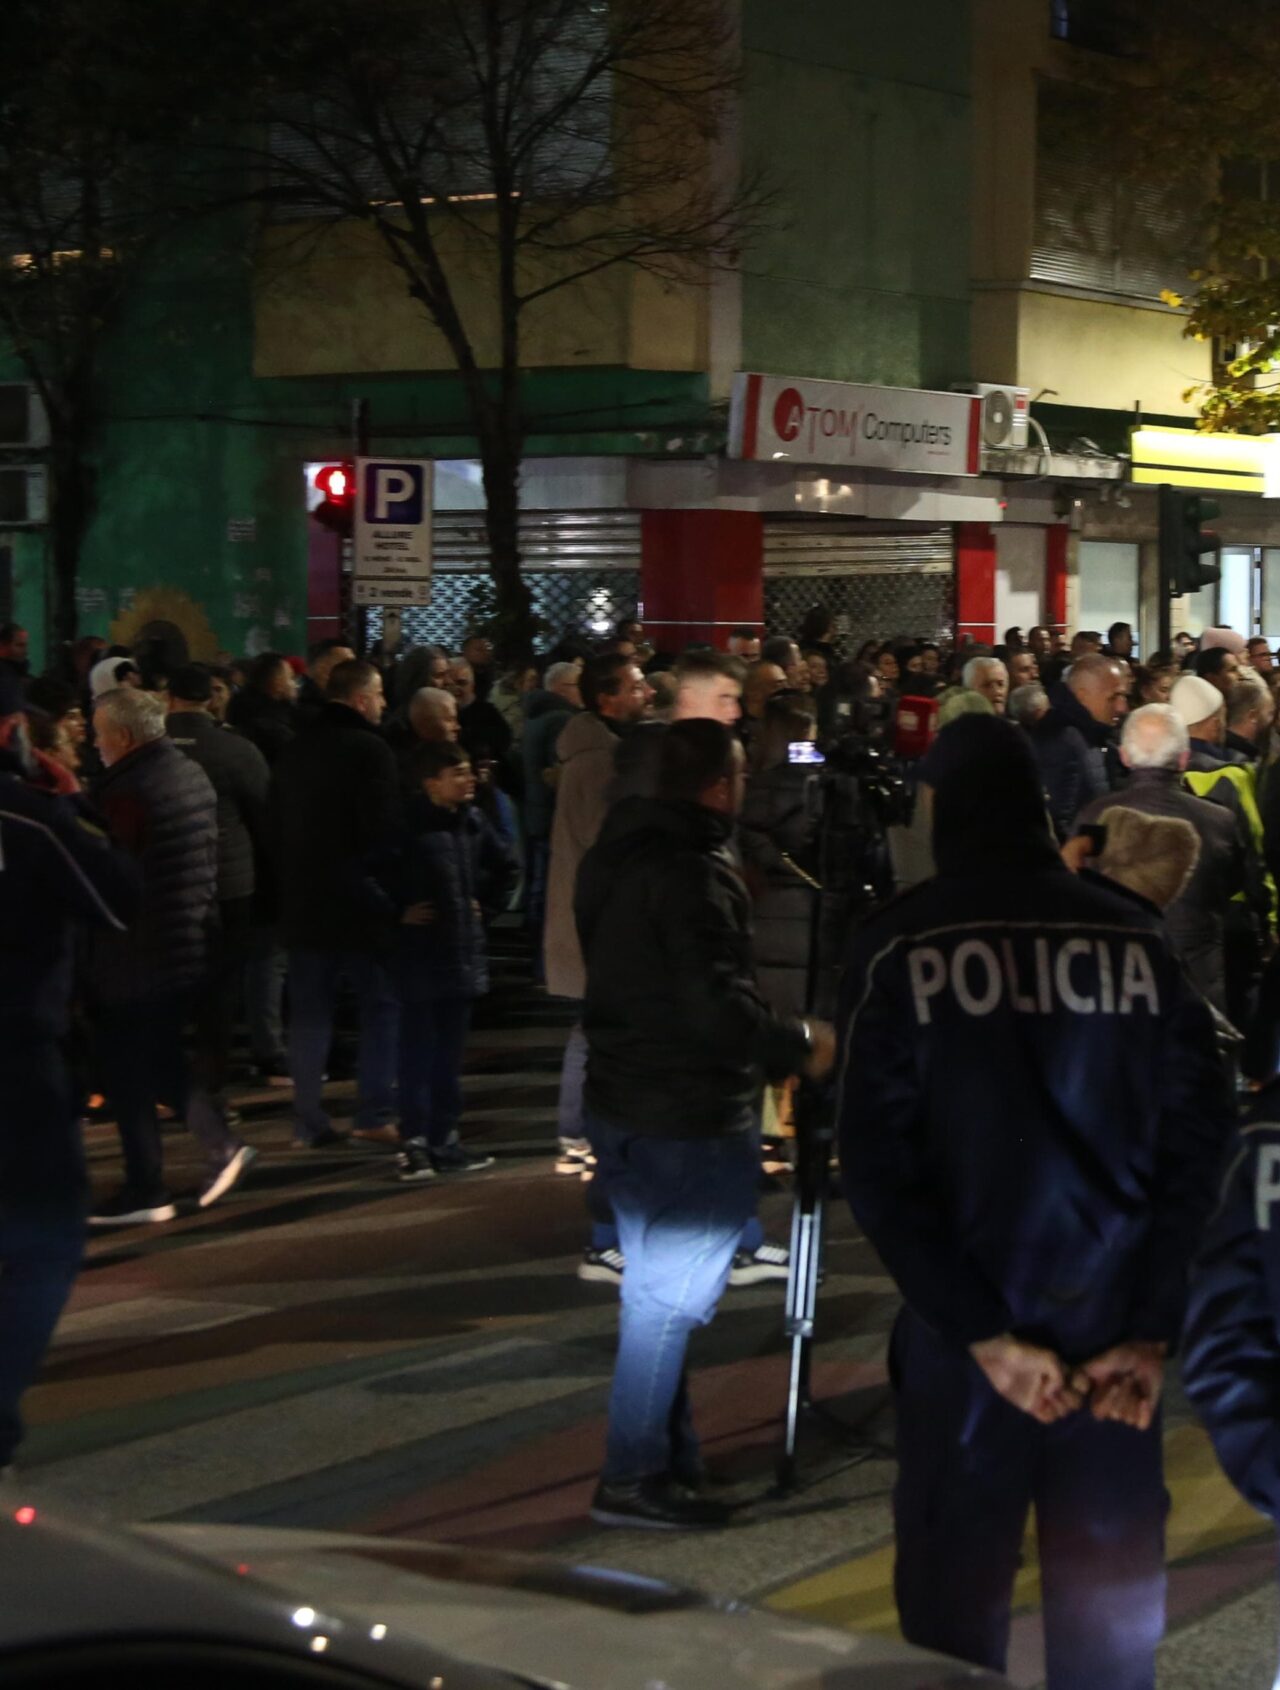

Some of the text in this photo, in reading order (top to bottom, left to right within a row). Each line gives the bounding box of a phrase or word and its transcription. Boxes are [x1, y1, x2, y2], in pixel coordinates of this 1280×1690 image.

[862, 413, 952, 448] Computers
[374, 469, 416, 519] P
[907, 938, 1160, 1025] POLICIA
